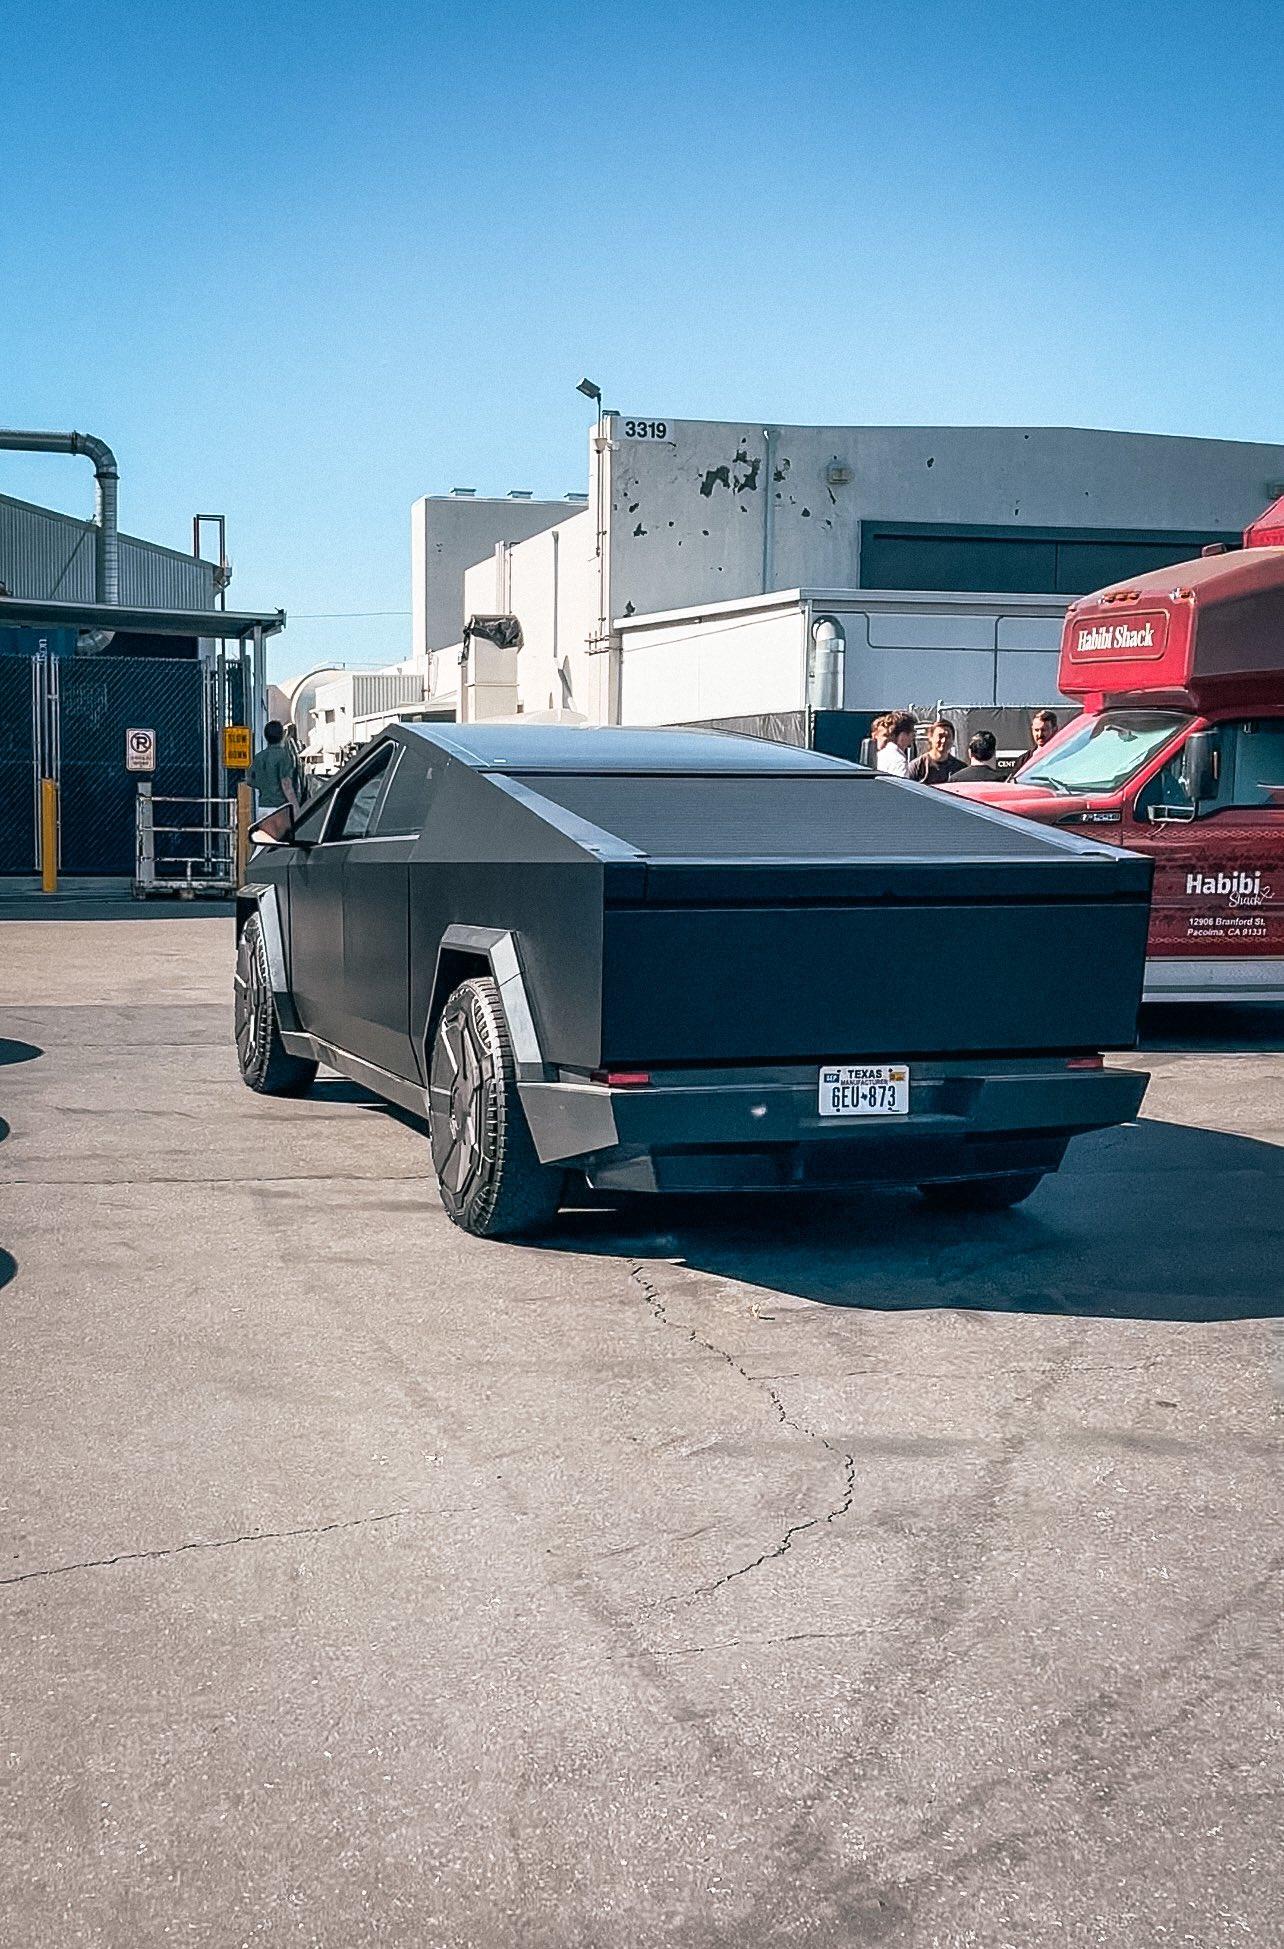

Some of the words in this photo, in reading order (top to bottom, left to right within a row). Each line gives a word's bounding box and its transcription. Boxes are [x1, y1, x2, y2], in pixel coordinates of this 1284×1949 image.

[625, 421, 667, 439] 3319
[1077, 626, 1114, 652] Habibi
[1113, 622, 1155, 649] Shack
[1186, 870, 1262, 895] Habibi
[1215, 917, 1253, 926] Branford
[1227, 928, 1241, 936] CA
[1242, 928, 1267, 936] 91331
[847, 1069, 883, 1079] TEXAS
